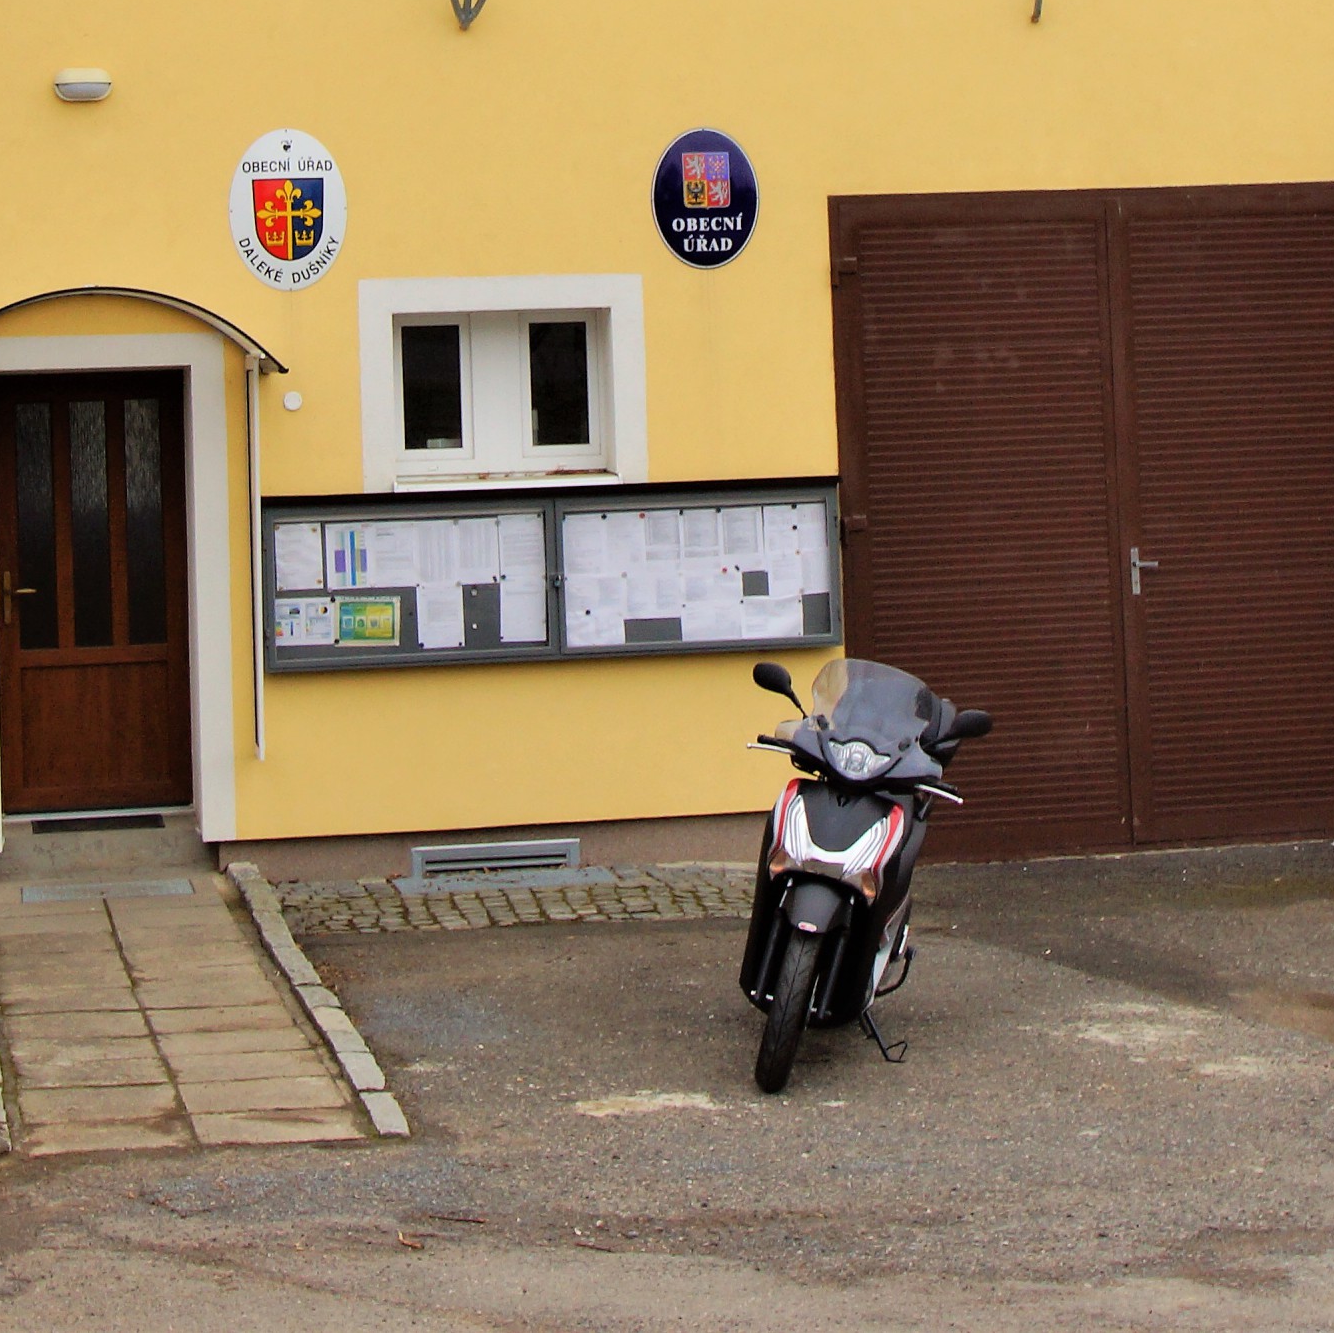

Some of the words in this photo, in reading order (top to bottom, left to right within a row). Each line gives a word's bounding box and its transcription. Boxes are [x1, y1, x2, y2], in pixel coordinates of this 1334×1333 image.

[242, 158, 290, 173] OBECNÍ
[298, 156, 333, 172] ÚŘAD
[672, 212, 743, 232] OBECNÍ
[683, 234, 733, 252] ÚŘAD
[239, 237, 284, 283] DALEKÉ
[292, 235, 340, 284] DUŠNÍKY
